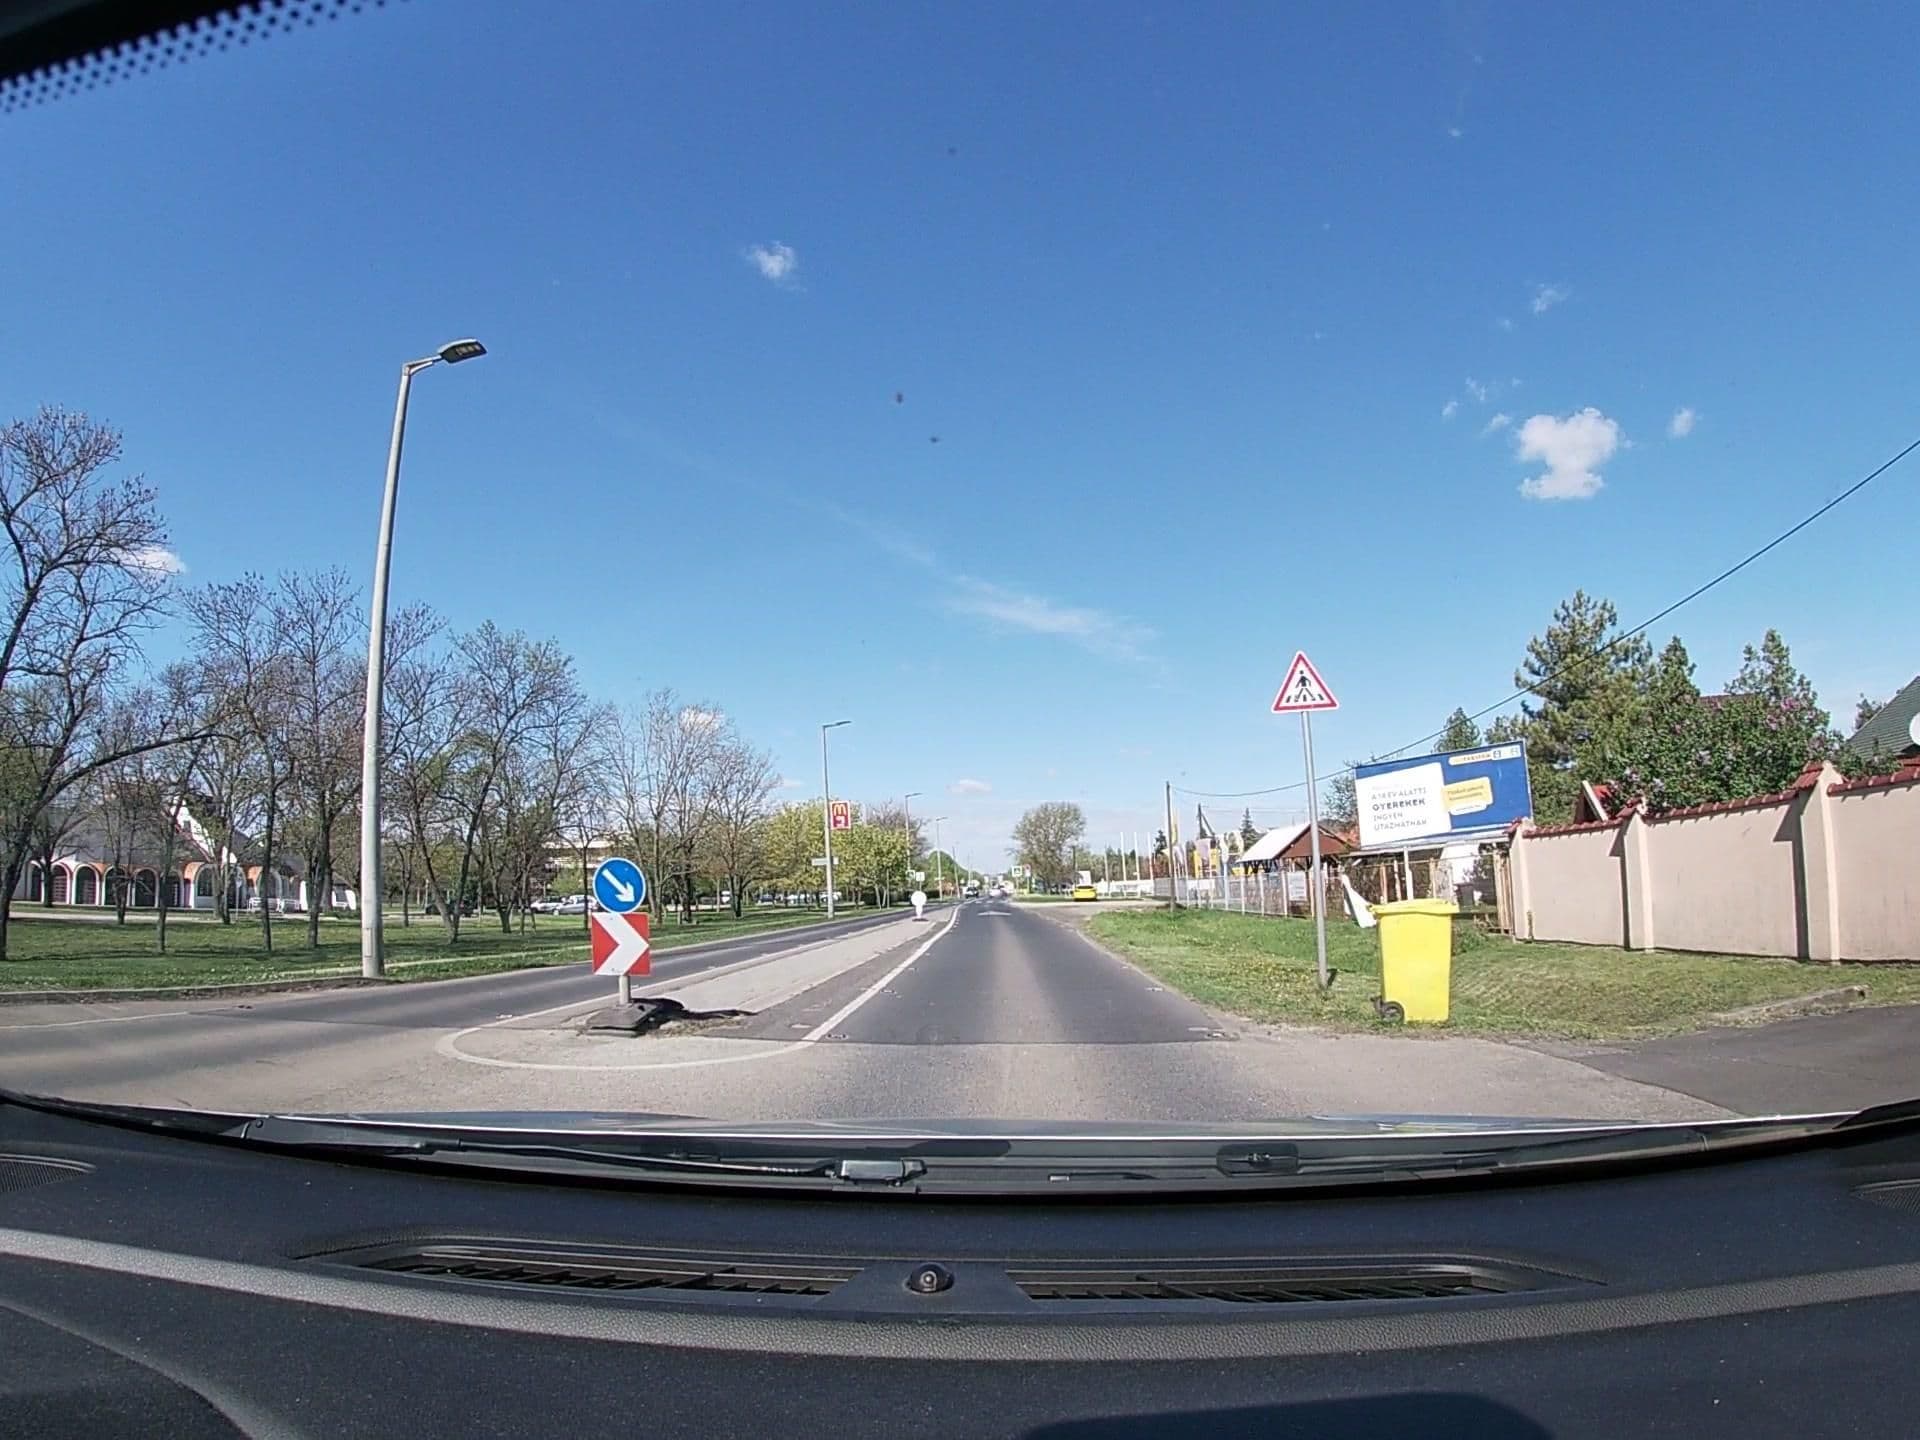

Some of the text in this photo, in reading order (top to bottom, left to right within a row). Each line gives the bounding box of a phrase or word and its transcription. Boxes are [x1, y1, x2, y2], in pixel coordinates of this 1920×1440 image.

[1372, 798, 1426, 811] GYEREKEK
[1373, 812, 1403, 822] INGYEN
[1374, 818, 1427, 831] UTAZHATNAK
